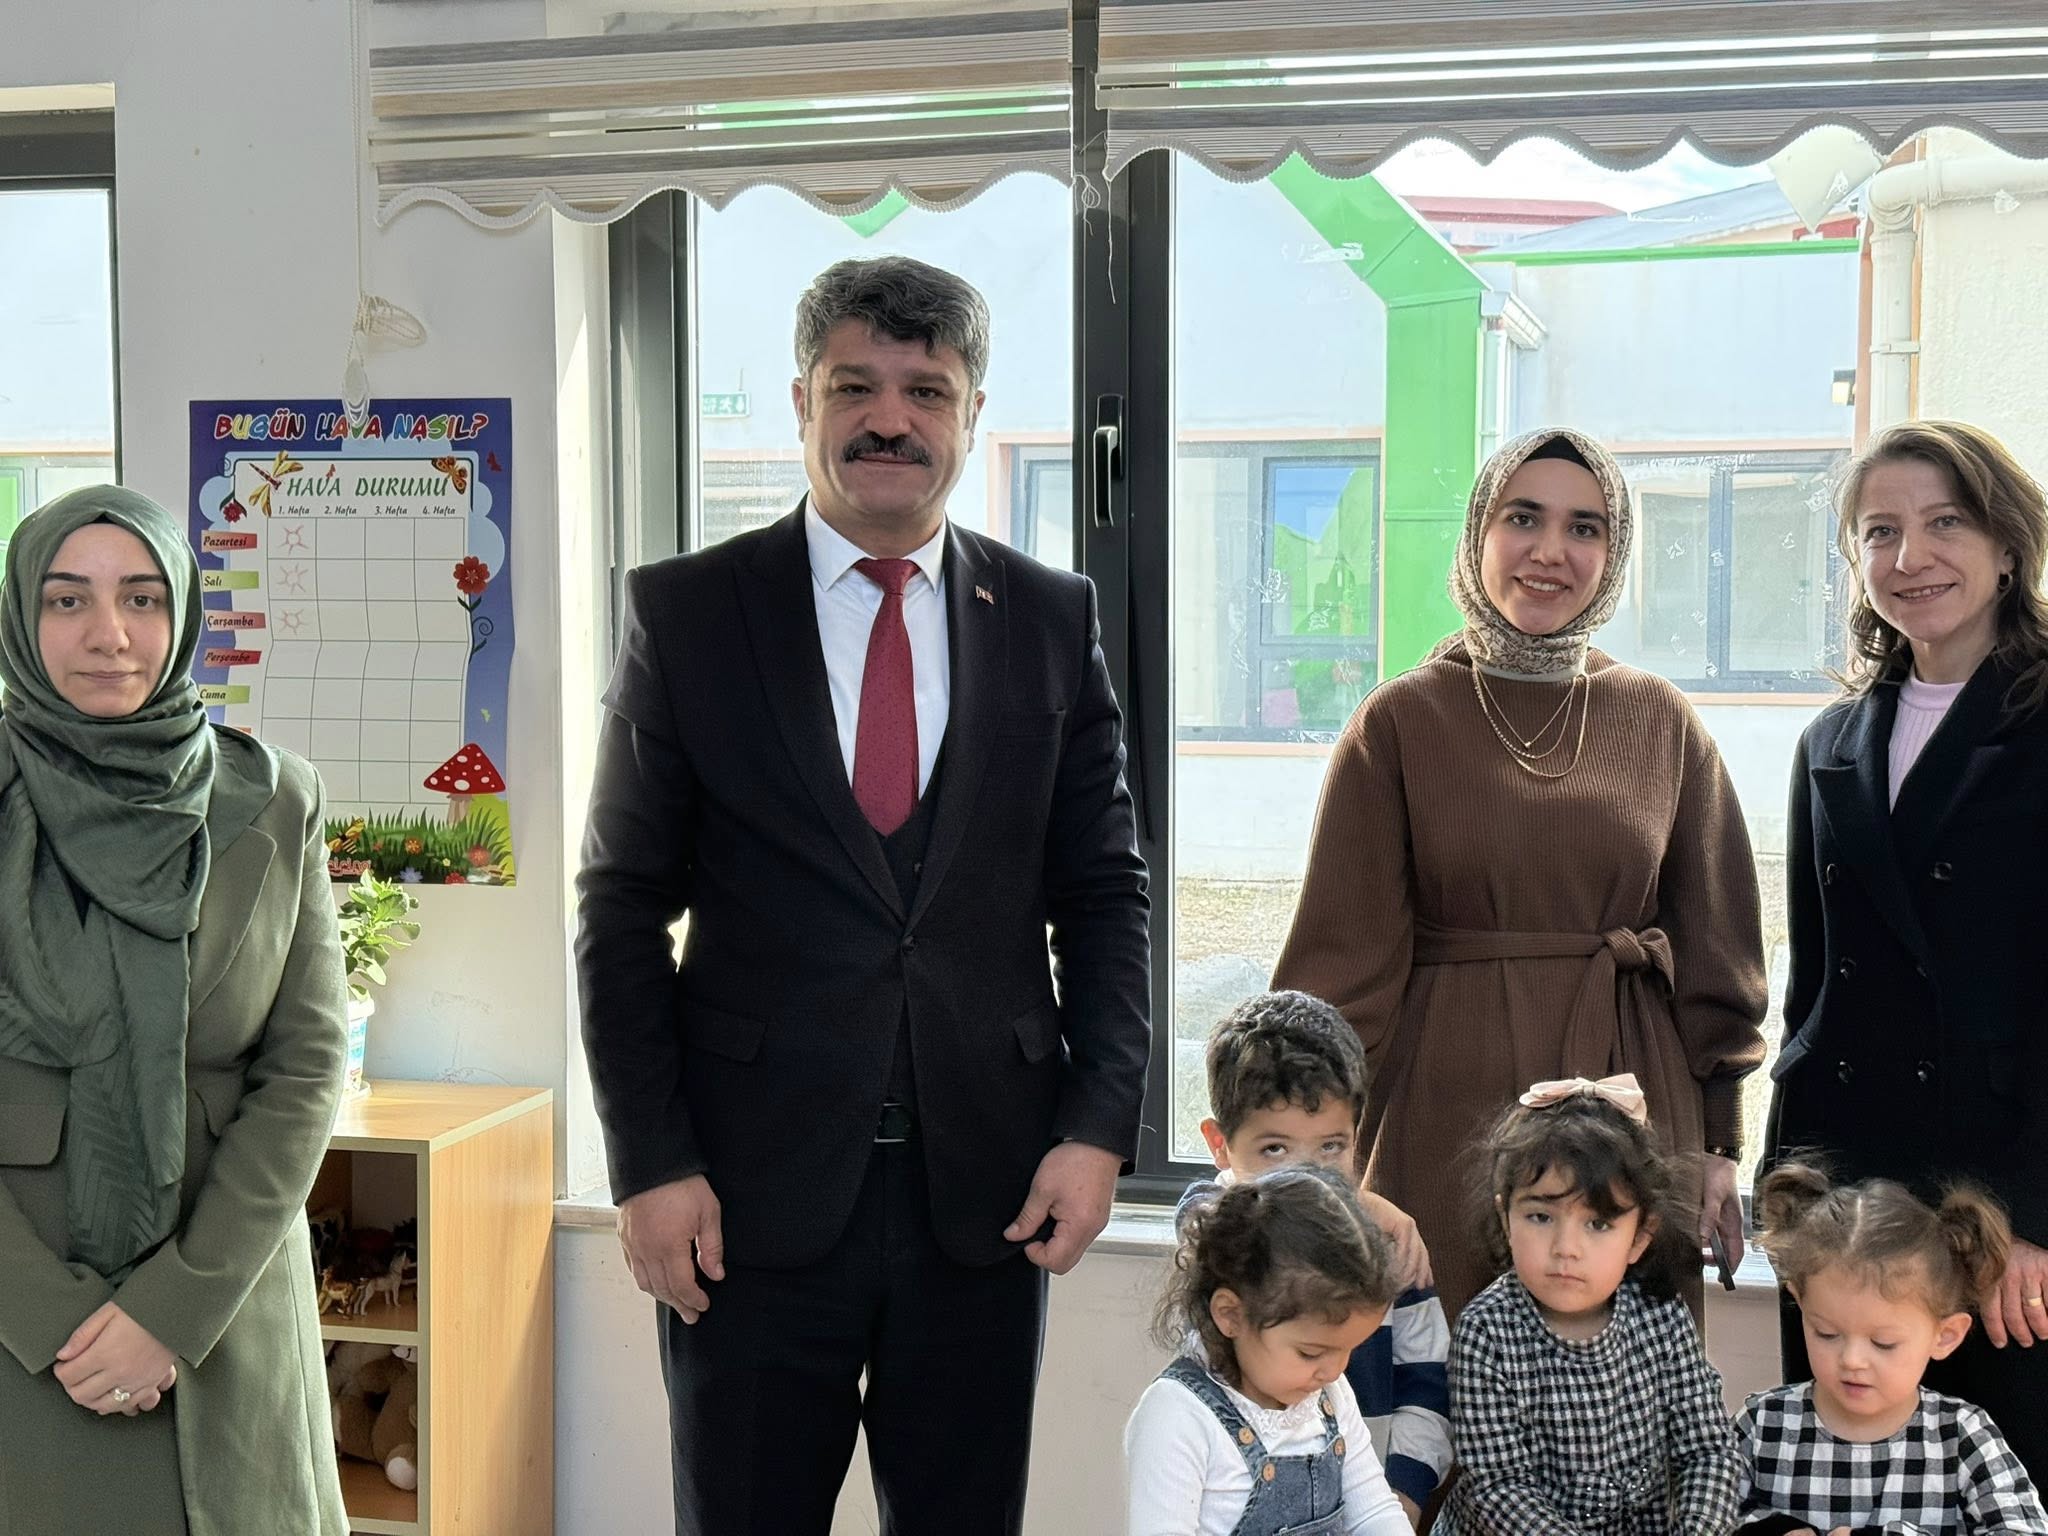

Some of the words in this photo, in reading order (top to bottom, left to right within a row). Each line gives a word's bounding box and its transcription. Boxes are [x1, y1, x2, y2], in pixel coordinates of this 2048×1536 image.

[214, 408, 306, 440] BUGÜN
[315, 412, 382, 440] HAVA
[393, 413, 488, 440] NASIL?
[287, 477, 341, 497] HAVA
[355, 477, 449, 497] DURUMU
[278, 505, 285, 515] 1.
[287, 505, 310, 517] Hafta
[324, 505, 332, 515] 2.
[335, 505, 357, 517] Hafta
[375, 505, 382, 515] 3.
[385, 505, 408, 517] Hafta
[422, 505, 430, 515] 4.
[433, 505, 456, 517] Hafta
[203, 535, 247, 547] Pazartesi
[204, 575, 222, 587] Salı
[207, 615, 253, 628] Çarşamba
[205, 651, 251, 663] Perşembe
[199, 688, 226, 699] Cuma
